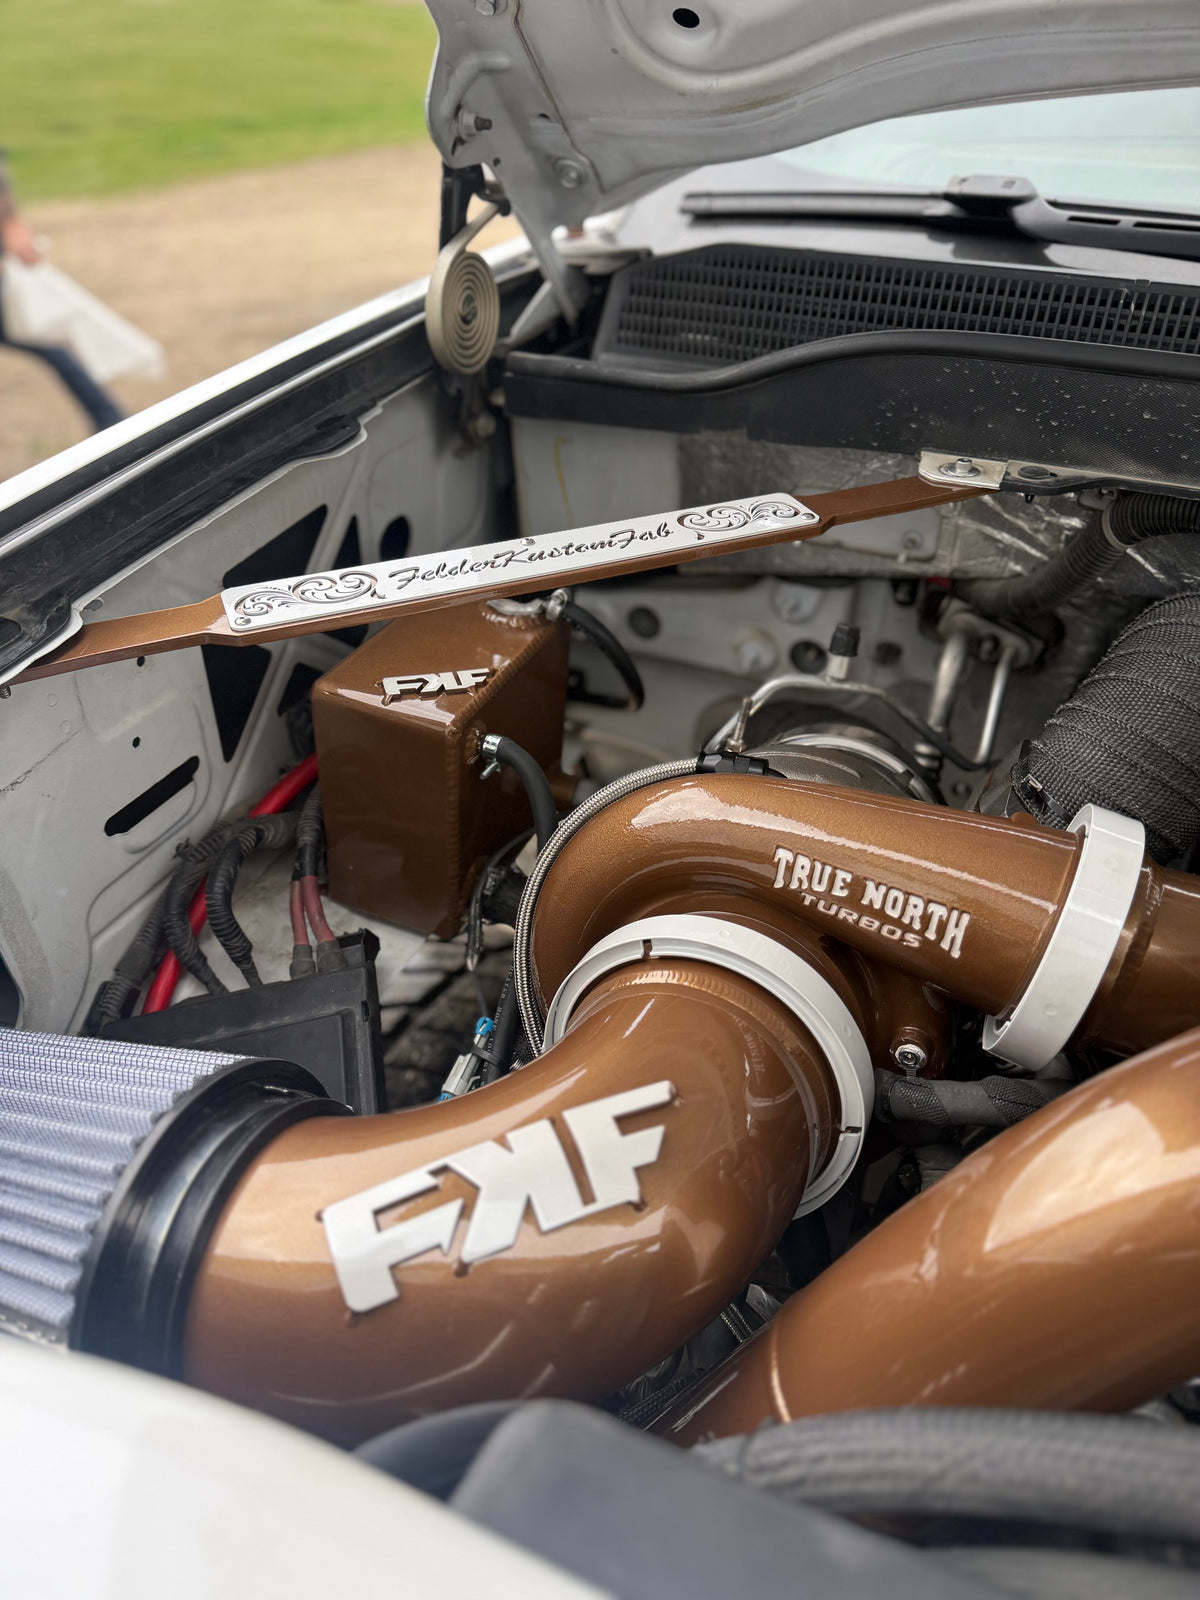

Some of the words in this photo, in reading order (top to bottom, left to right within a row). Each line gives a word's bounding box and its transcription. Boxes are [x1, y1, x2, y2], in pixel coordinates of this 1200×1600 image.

[382, 667, 490, 697] FKF
[773, 846, 853, 897] TRUE
[860, 878, 971, 959] NORTH
[801, 892, 924, 948] TURBOS
[322, 1080, 675, 1313] FKF
